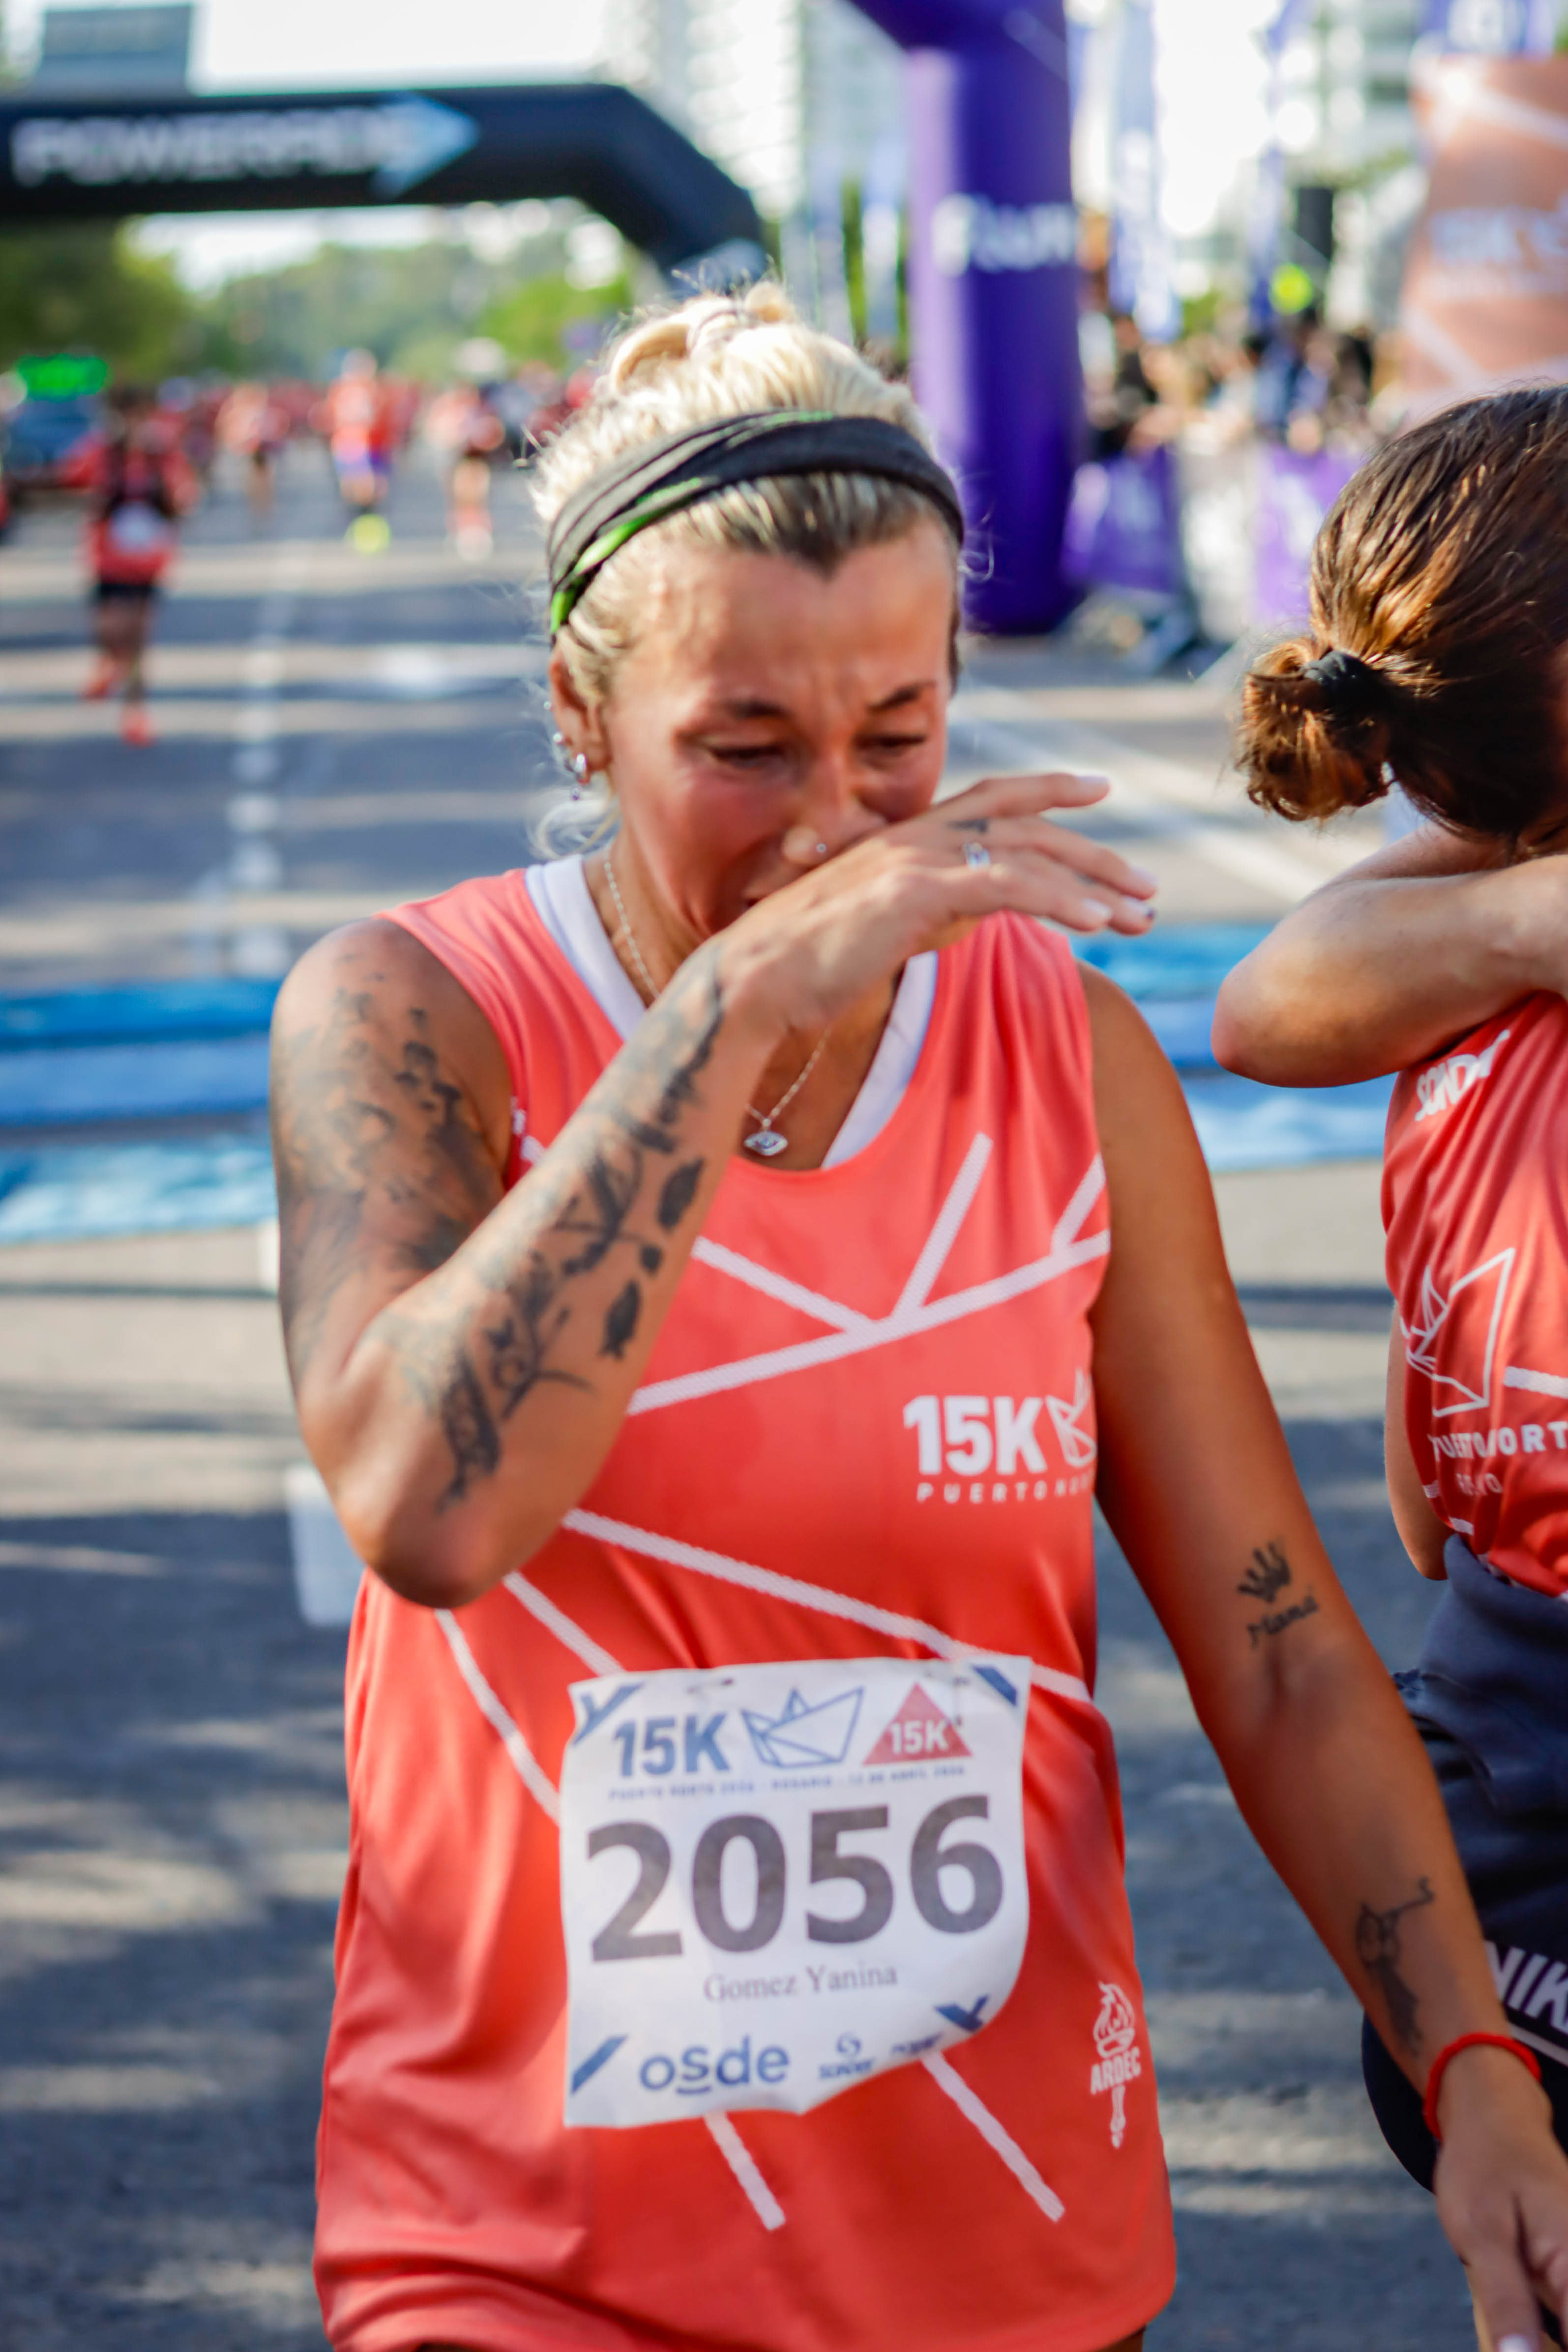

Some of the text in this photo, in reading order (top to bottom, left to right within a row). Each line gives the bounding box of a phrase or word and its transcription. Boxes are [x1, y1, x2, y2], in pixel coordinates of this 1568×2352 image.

[903, 1395, 1048, 1475] 15K
[916, 1479, 1048, 1503] PUERTO
[614, 1711, 731, 1777] 15K
[889, 1718, 950, 1756] 15K
[587, 1794, 1004, 1962] 2056
[704, 1963, 899, 2002] Gomez Yanina
[639, 2034, 790, 2095] osde
